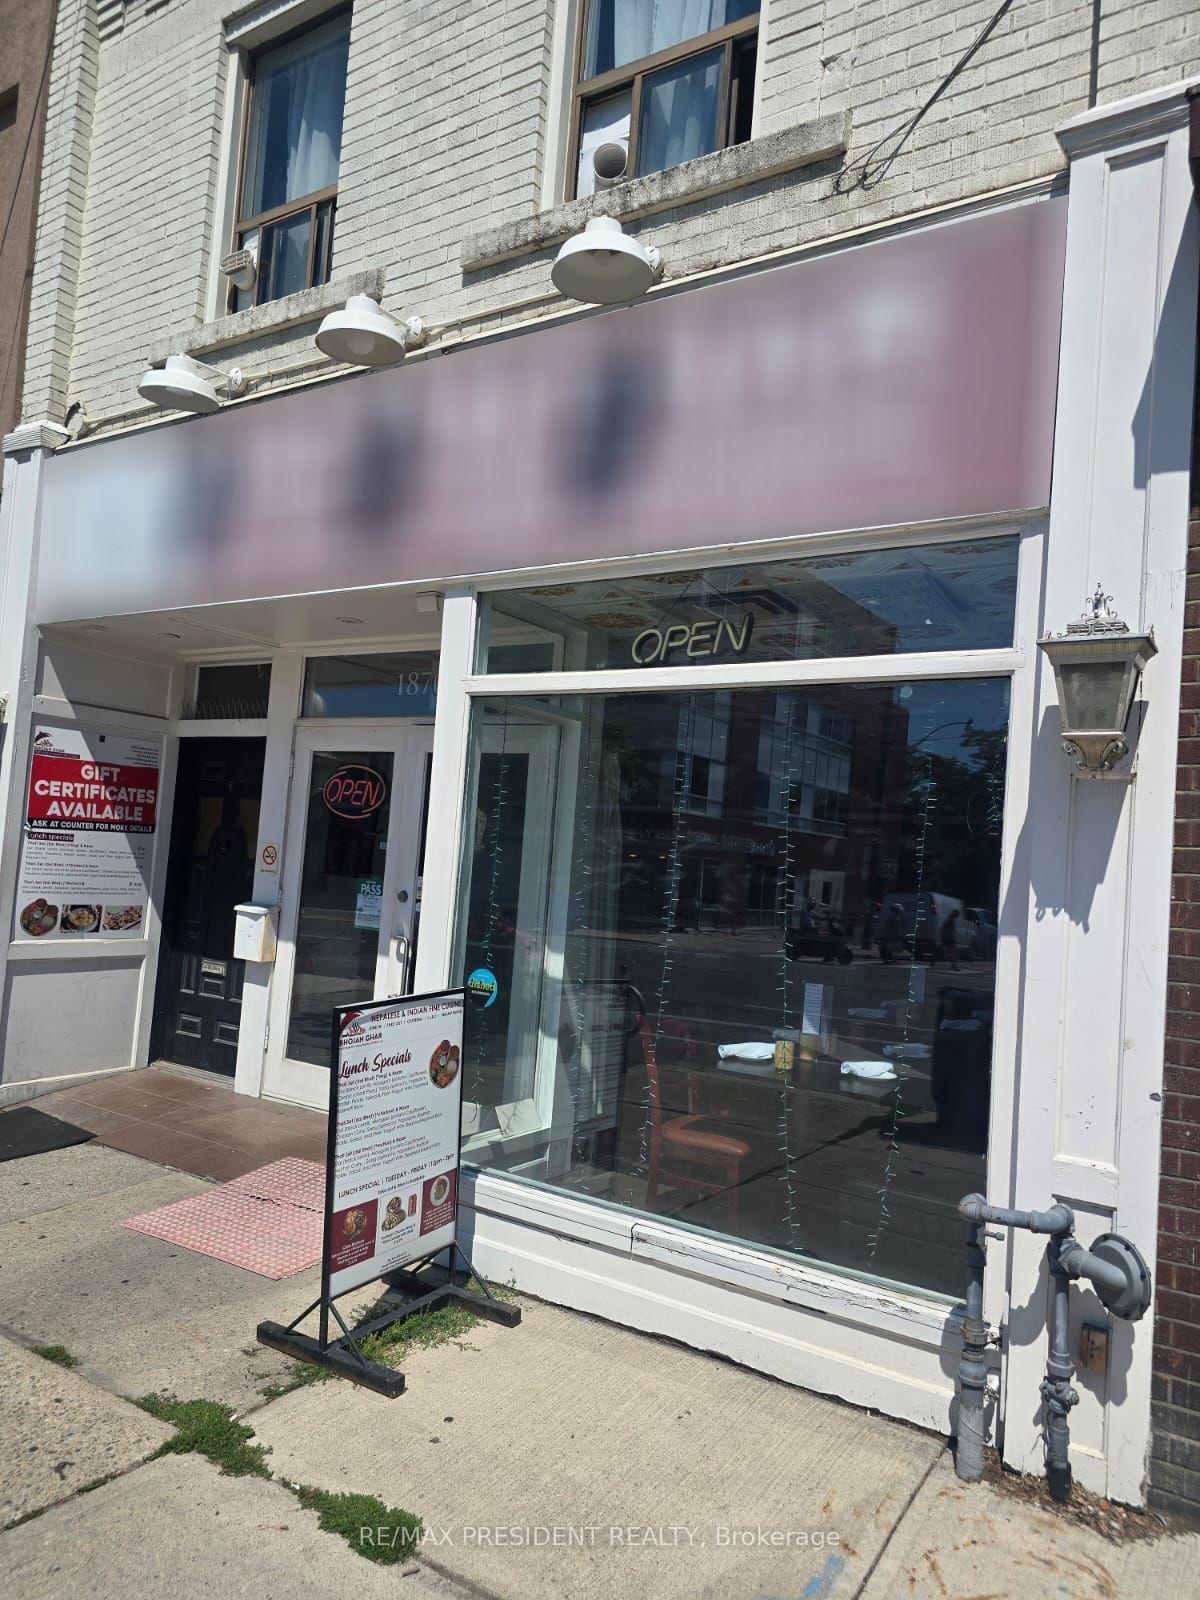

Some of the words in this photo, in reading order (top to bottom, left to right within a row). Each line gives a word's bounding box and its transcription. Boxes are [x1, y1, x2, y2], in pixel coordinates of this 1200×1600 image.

[631, 615, 751, 664] OPEN
[81, 764, 120, 782] GIFT
[34, 779, 156, 804] CERTIFICATES
[326, 778, 380, 806] OPEN
[47, 801, 144, 821] AVAILABLE
[49, 820, 59, 828] AT
[60, 822, 95, 830] COUNTER
[111, 823, 128, 832] MORE
[30, 832, 47, 840] unch
[361, 883, 382, 896] PASS
[370, 1010, 400, 1022] NEPALESE
[407, 1006, 428, 1017] INDIAN
[429, 1003, 441, 1012] FINE
[366, 1032, 383, 1041] GHAR
[339, 1057, 369, 1078] Lunch
[372, 1048, 413, 1073] Specials
[338, 1187, 358, 1198] LUNCH
[358, 1180, 380, 1192] SPECIAL
[385, 1170, 407, 1182] TUESDAY
[410, 1163, 427, 1174] FRIDAY
